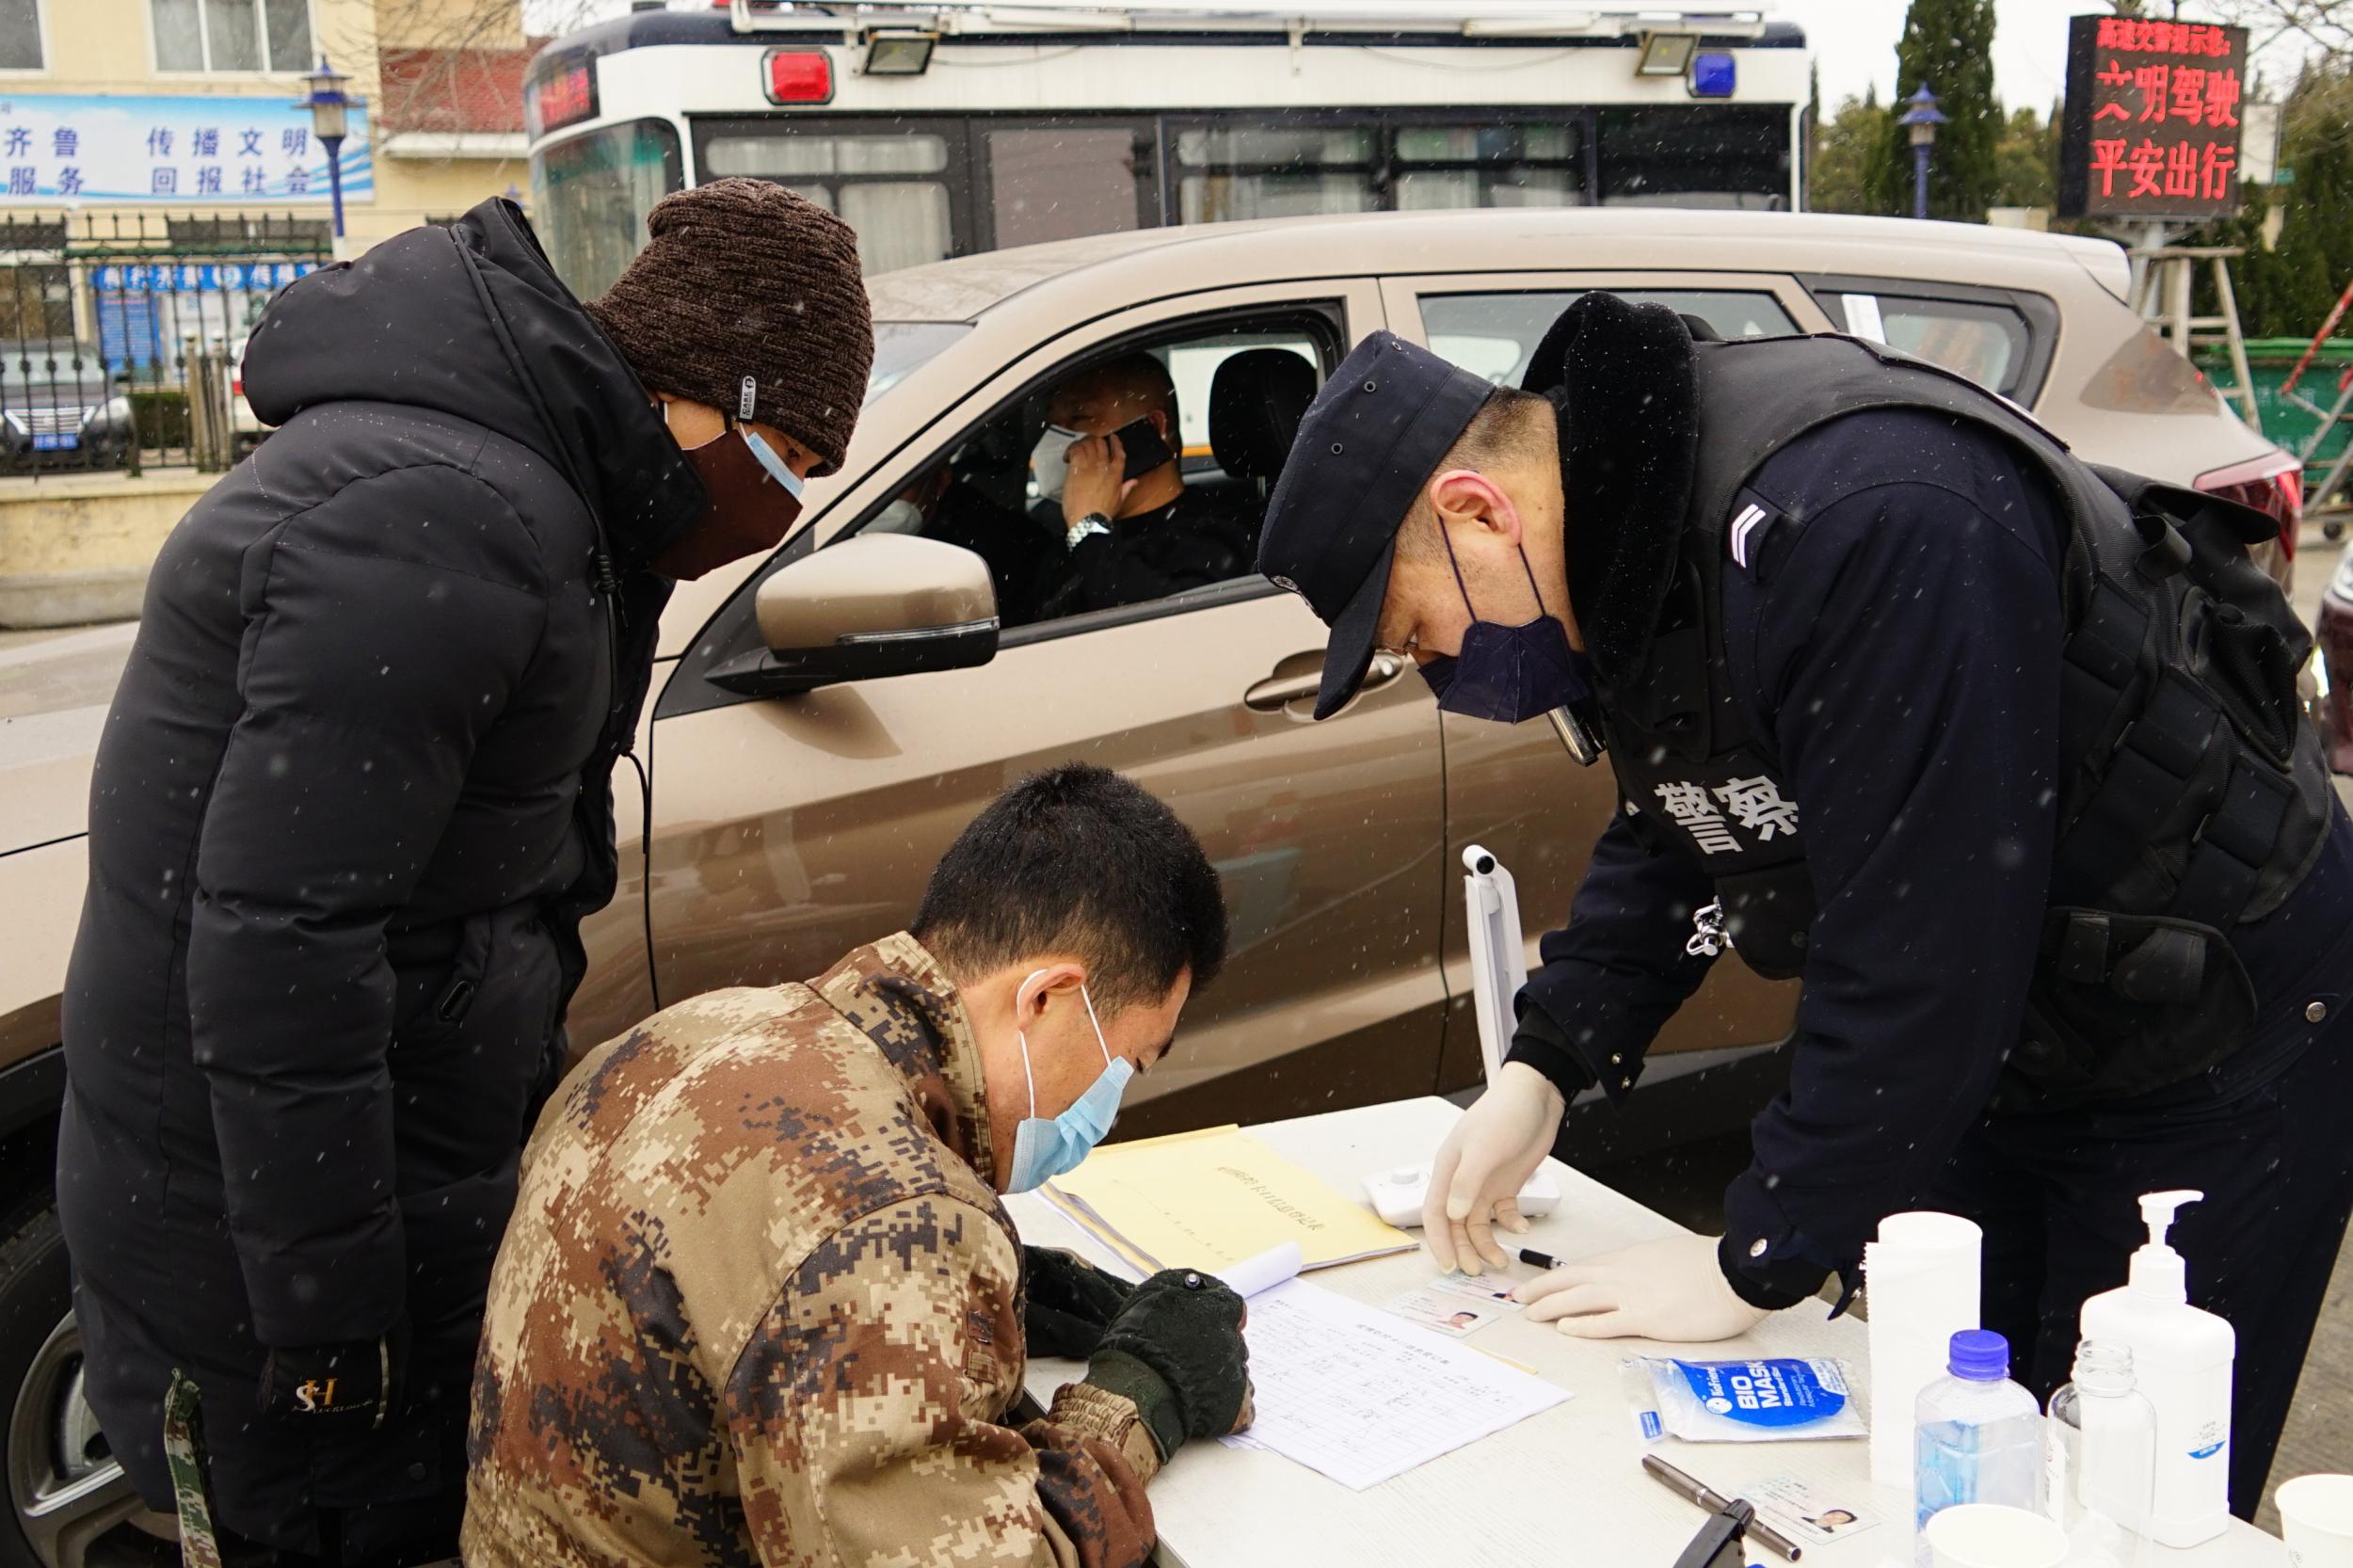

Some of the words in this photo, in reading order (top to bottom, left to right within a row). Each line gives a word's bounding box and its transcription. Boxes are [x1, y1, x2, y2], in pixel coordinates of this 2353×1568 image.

[6, 126, 81, 159] 齐鲁
[146, 126, 309, 159] 传播文明
[8, 166, 85, 197] 服务
[151, 166, 312, 197] 回报社会
[2089, 137, 2236, 200] 平安出行
[1653, 775, 1800, 855] 警察
[1730, 1375, 1760, 1409] BIO
[1745, 1361, 1782, 1409] MASK
